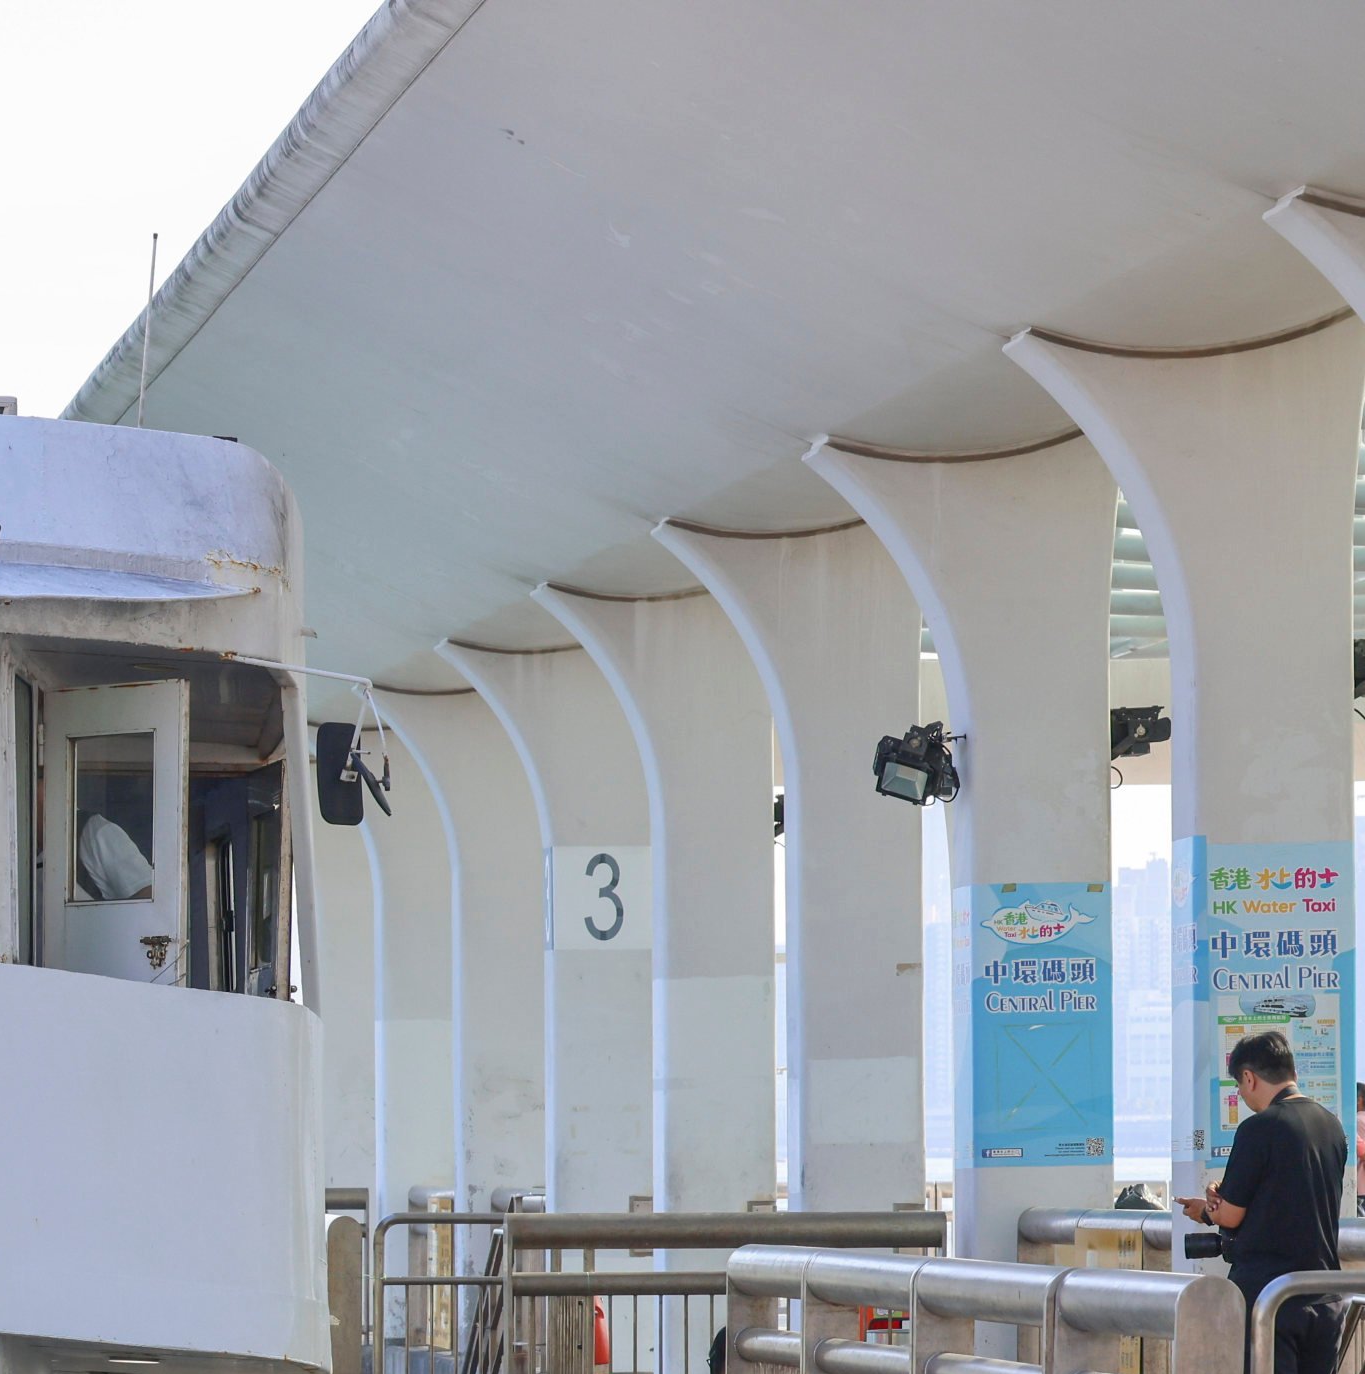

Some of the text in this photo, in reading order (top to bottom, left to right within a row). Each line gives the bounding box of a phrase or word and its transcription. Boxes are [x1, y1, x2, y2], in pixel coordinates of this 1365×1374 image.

[1209, 867, 1339, 890] 香港水上的士
[584, 853, 624, 941] 3
[1213, 898, 1336, 914] HK Water Taxi
[1004, 911, 1028, 926] 香港
[1019, 923, 1065, 939] 水上的士
[1211, 929, 1338, 959] 中環碼頭
[984, 958, 1096, 985] 中環碼頭
